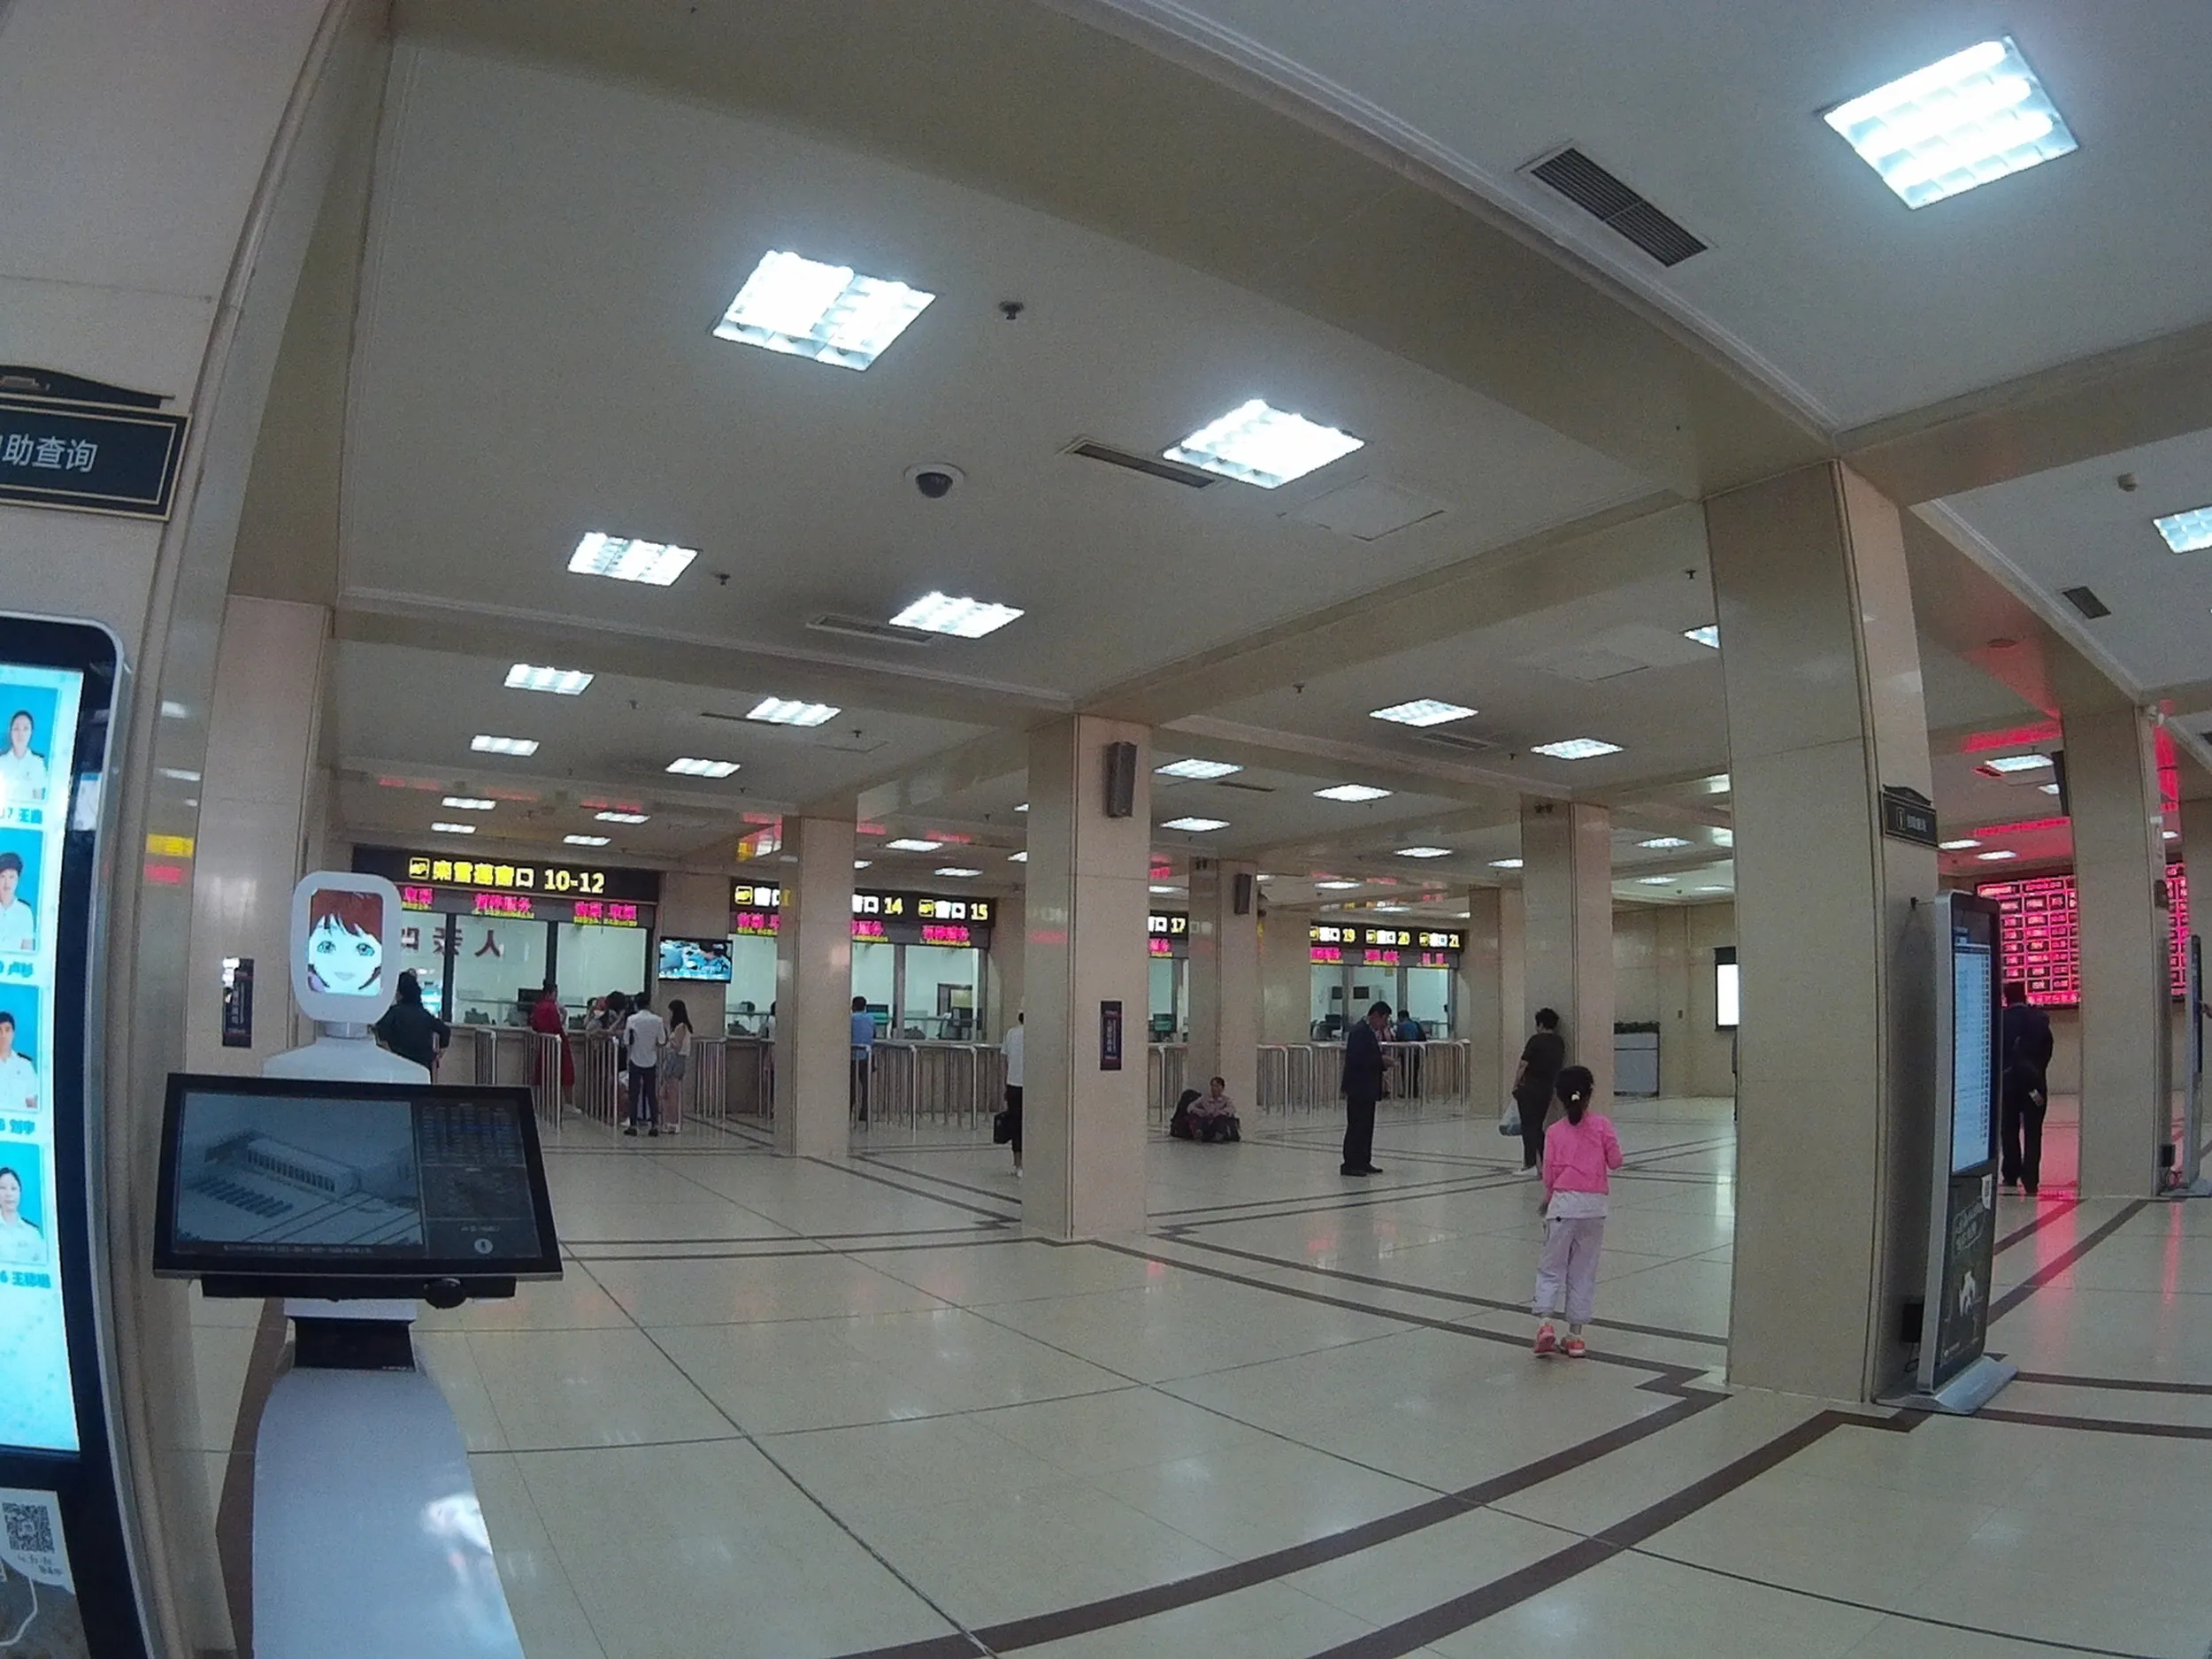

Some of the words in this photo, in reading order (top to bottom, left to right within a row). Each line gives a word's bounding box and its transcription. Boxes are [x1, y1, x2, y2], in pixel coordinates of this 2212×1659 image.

[0, 433, 98, 473] 助查询
[544, 869, 605, 894] 10-12
[884, 896, 903, 915] 14
[971, 902, 988, 920] 15
[1171, 917, 1186, 933] 17
